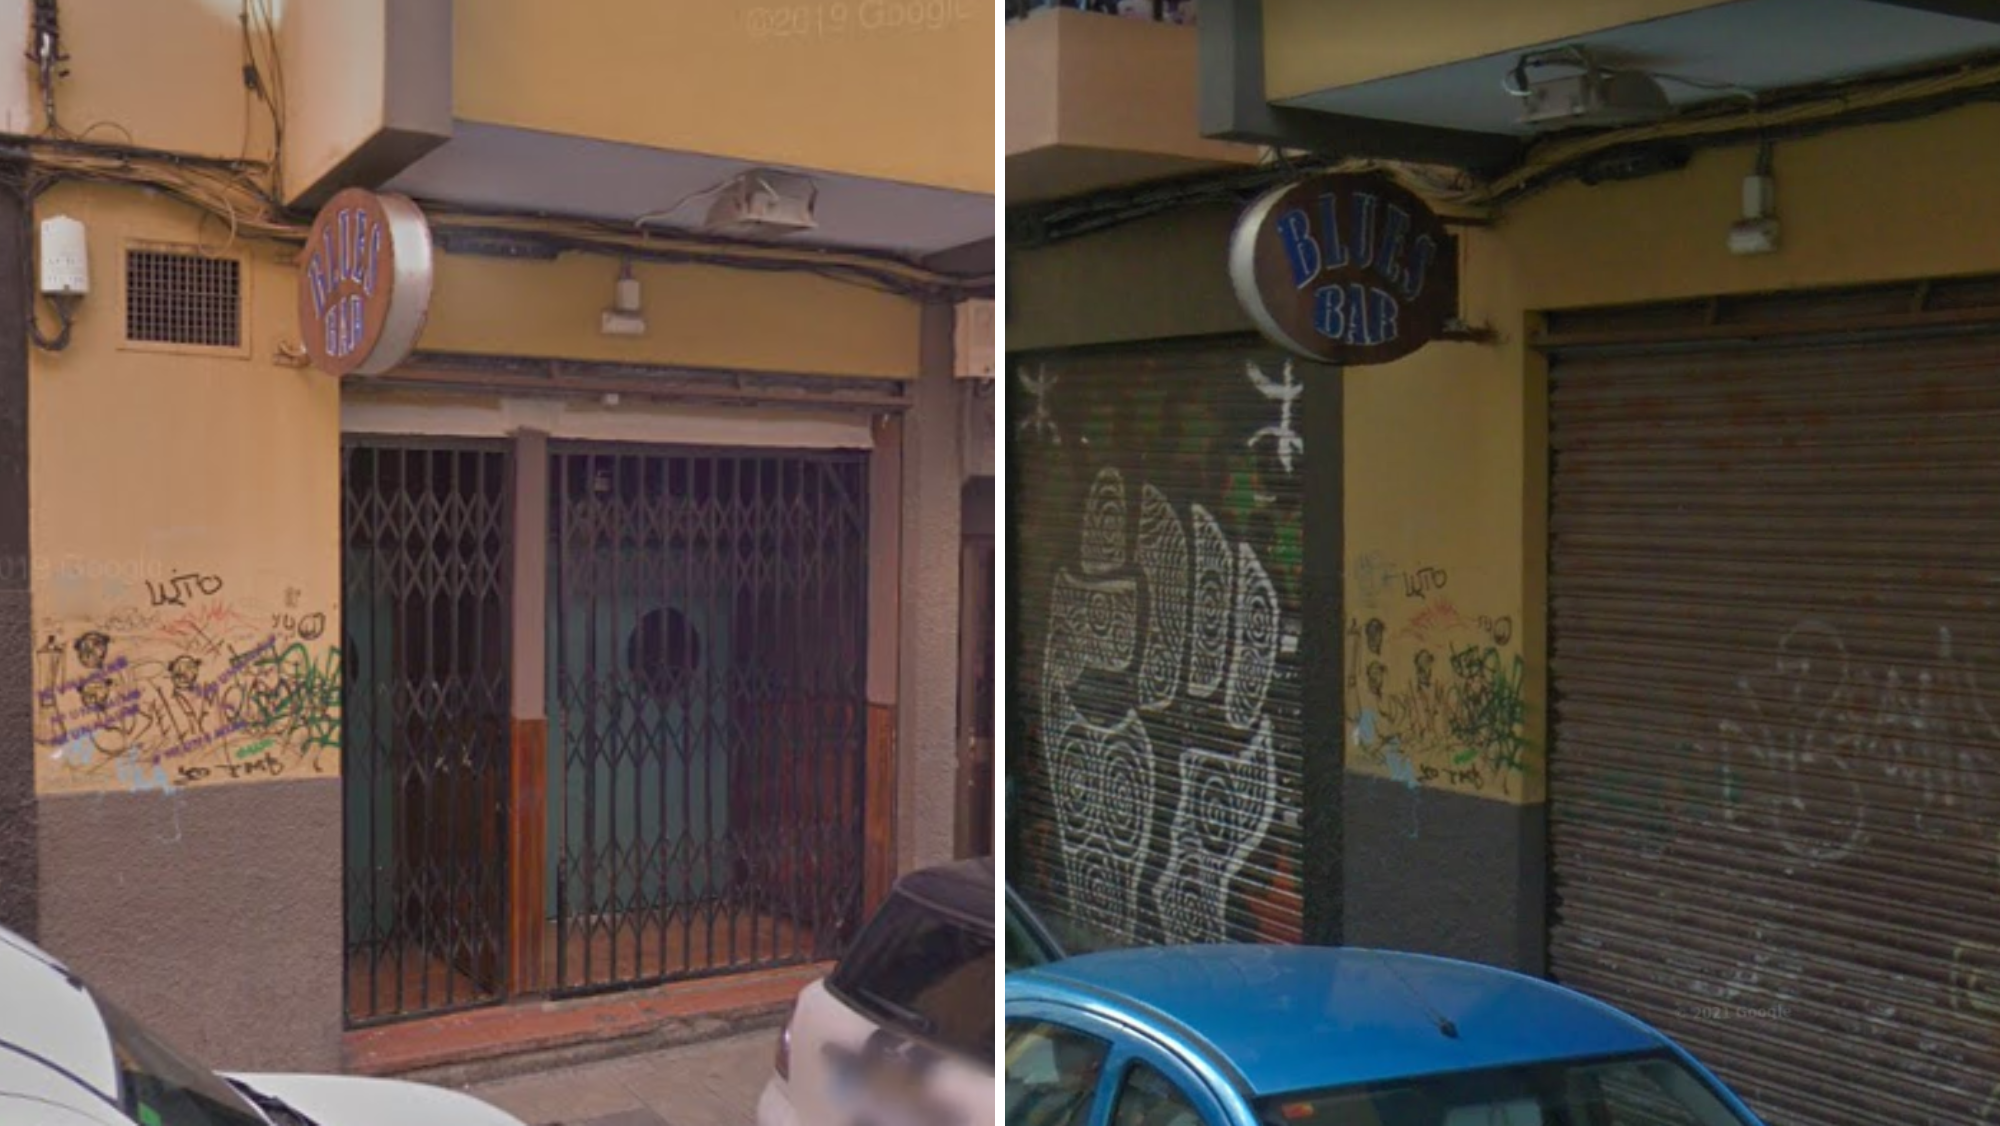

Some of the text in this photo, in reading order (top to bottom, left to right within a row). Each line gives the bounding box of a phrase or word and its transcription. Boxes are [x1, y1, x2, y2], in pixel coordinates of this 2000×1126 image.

[308, 207, 382, 319] BLUES
[1276, 191, 1437, 302] BLUES
[325, 293, 363, 357] BAR
[1314, 283, 1398, 345] BAR
